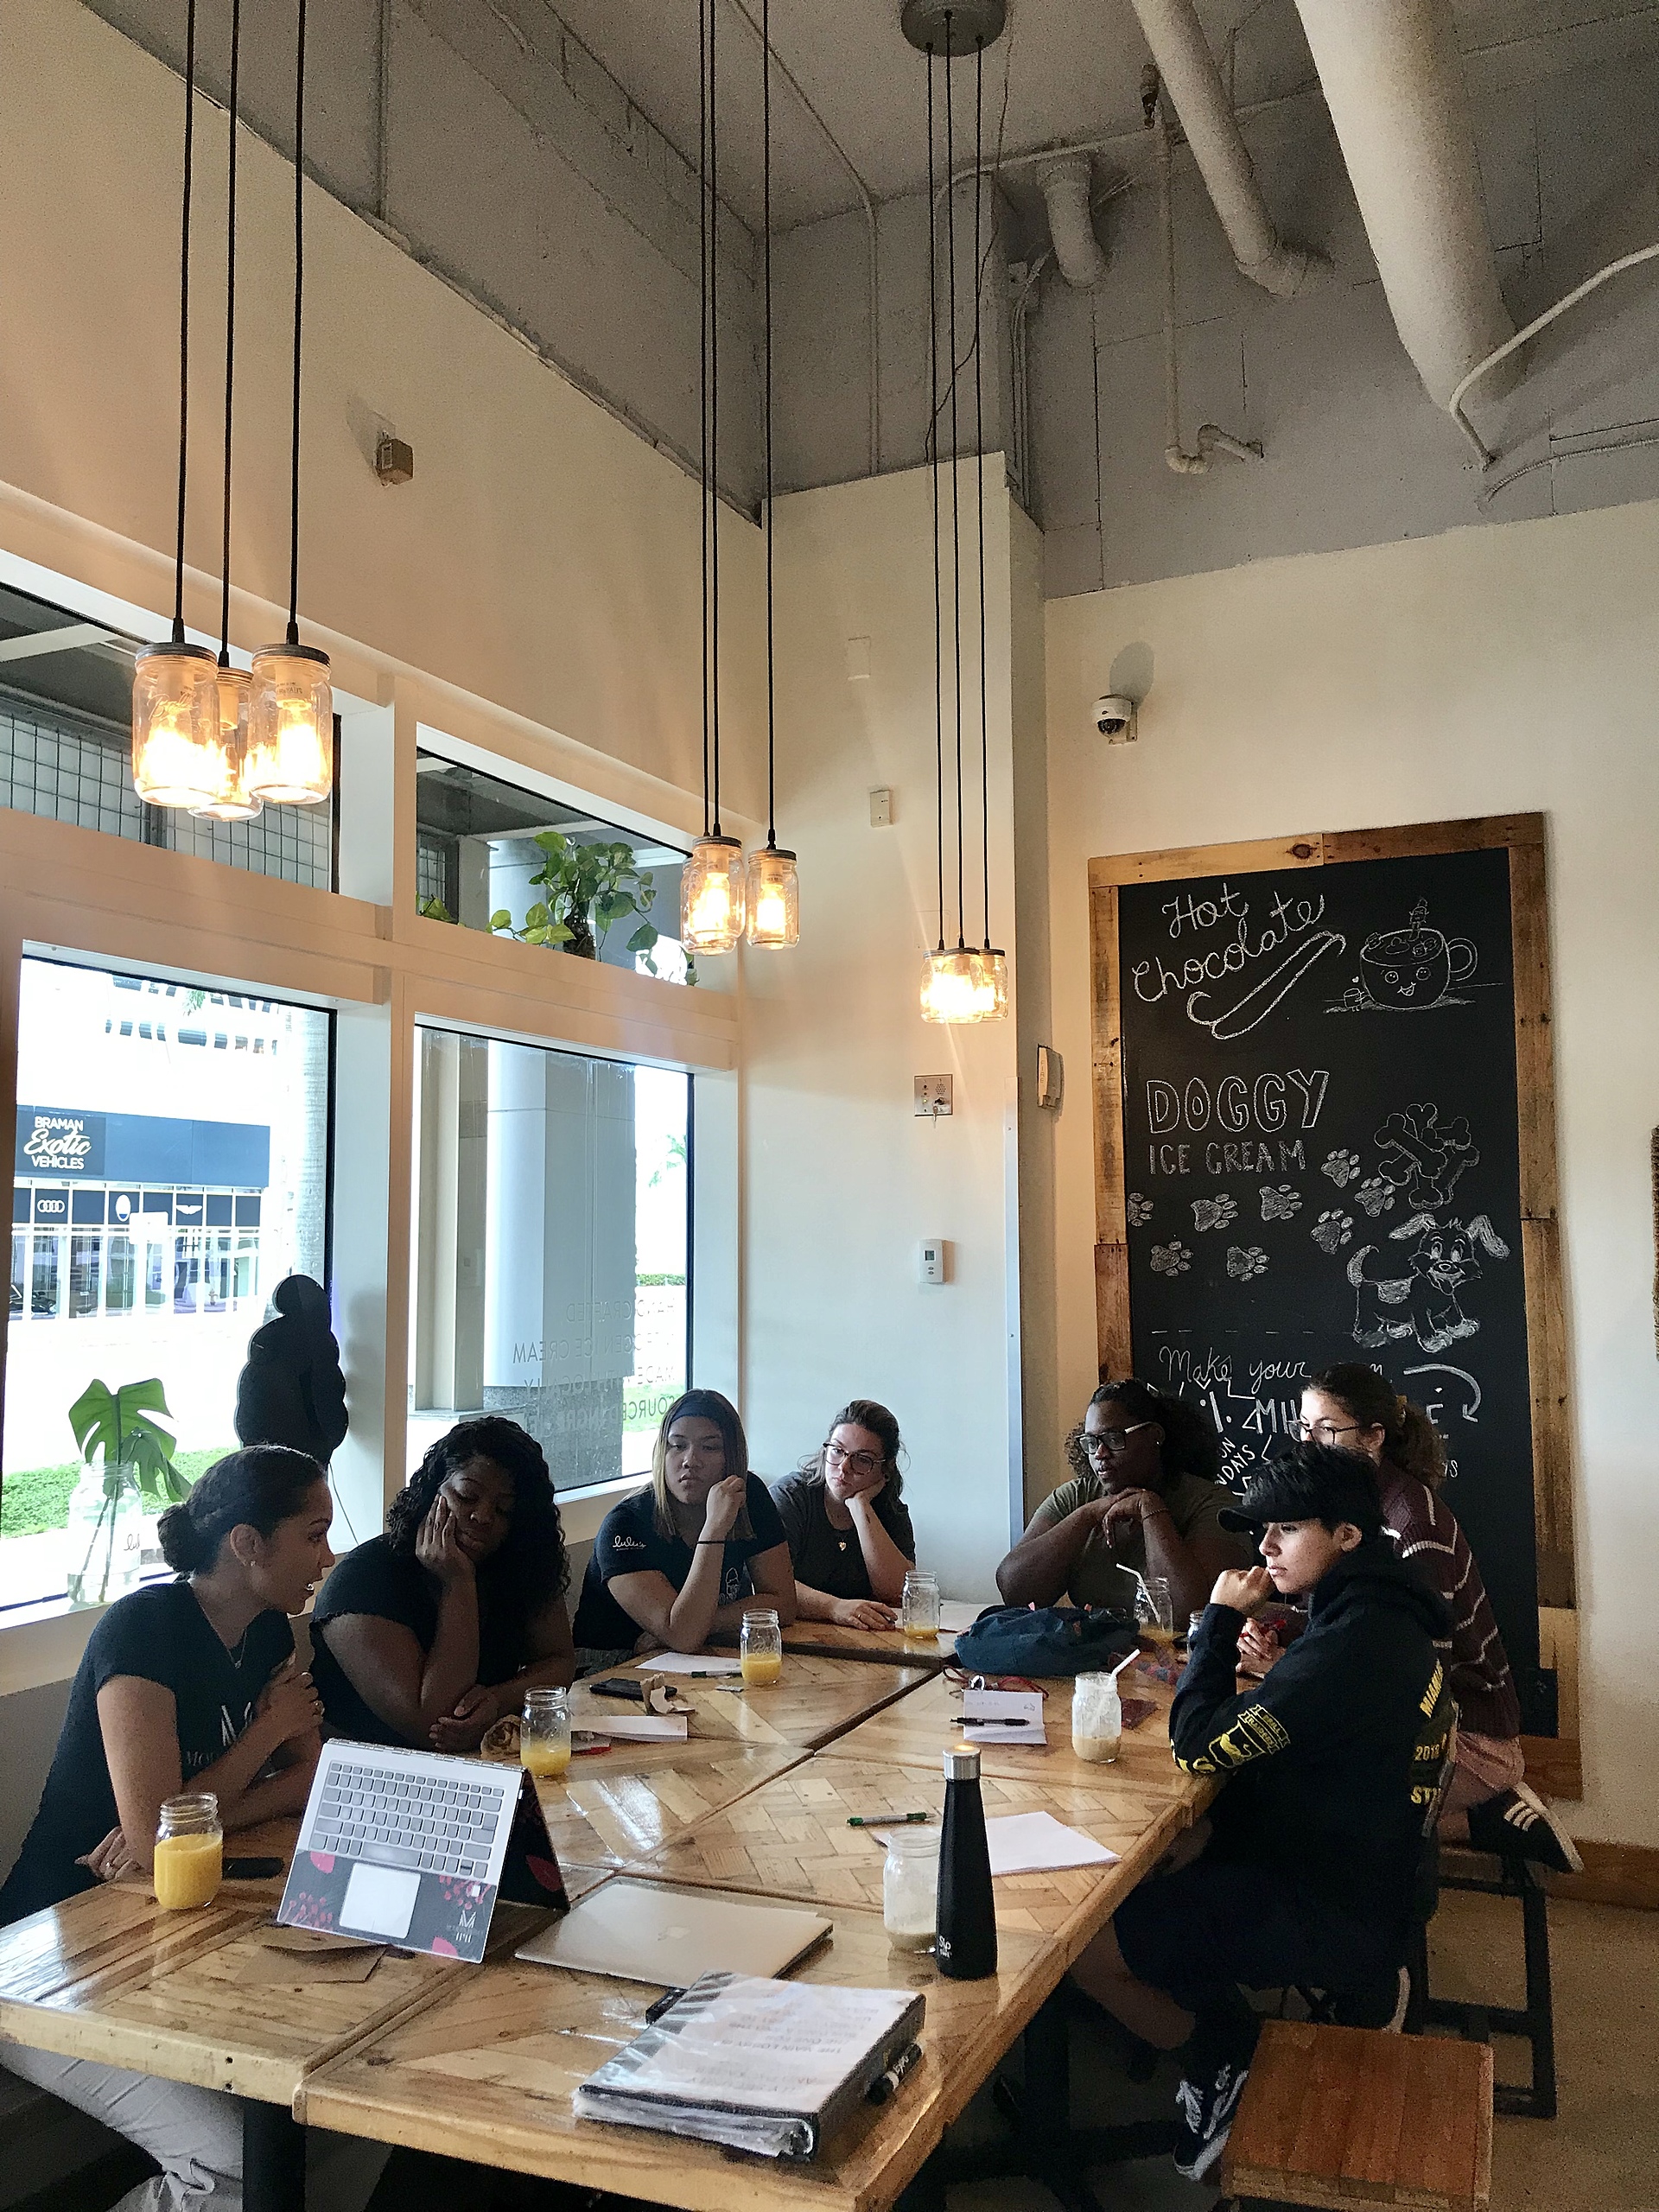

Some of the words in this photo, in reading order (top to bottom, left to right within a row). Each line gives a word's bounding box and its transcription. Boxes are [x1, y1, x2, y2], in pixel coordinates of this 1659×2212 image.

[1161, 882, 1249, 938] Hot
[1132, 891, 1325, 1001] Chocolate
[1146, 1069, 1330, 1133] DOGGY
[23, 1128, 92, 1156] Exotic
[35, 1116, 84, 1131] BRAMAN
[31, 1155, 85, 1170] VEHICLES
[1149, 1142, 1191, 1175] ICE
[1205, 1139, 1307, 1175] CREAM
[1159, 1345, 1233, 1383] Make
[1249, 1359, 1313, 1394] your
